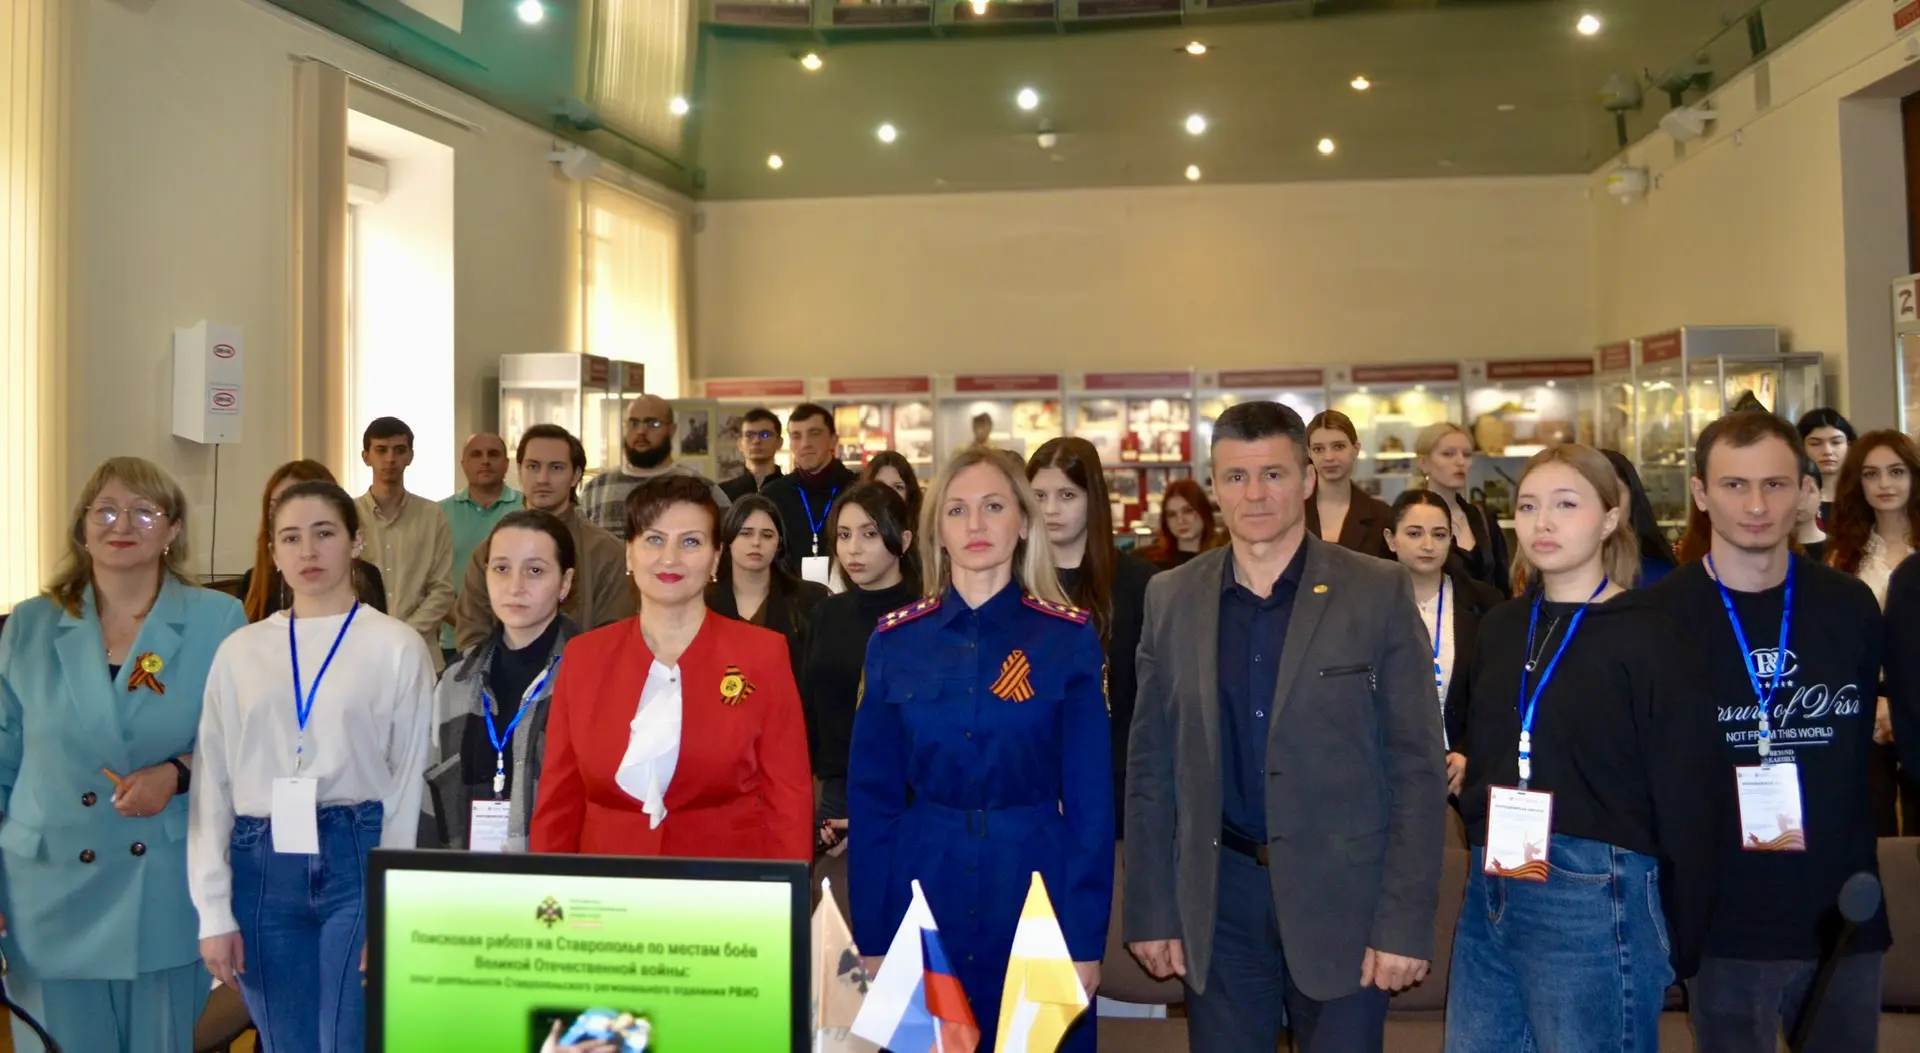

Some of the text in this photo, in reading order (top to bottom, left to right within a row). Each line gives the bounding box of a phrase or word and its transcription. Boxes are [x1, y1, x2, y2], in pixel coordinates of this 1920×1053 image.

[1898, 289, 1914, 316] 2
[1773, 686, 1805, 728] of
[1725, 726, 1834, 742] NOT FRM THIS WORLD
[411, 930, 758, 959] Поисковая работа на Ставрополье по местам боёв
[474, 955, 691, 978] Великой Отечественной войны:
[504, 976, 591, 991] Ставропольского
[594, 982, 671, 995] регионального
